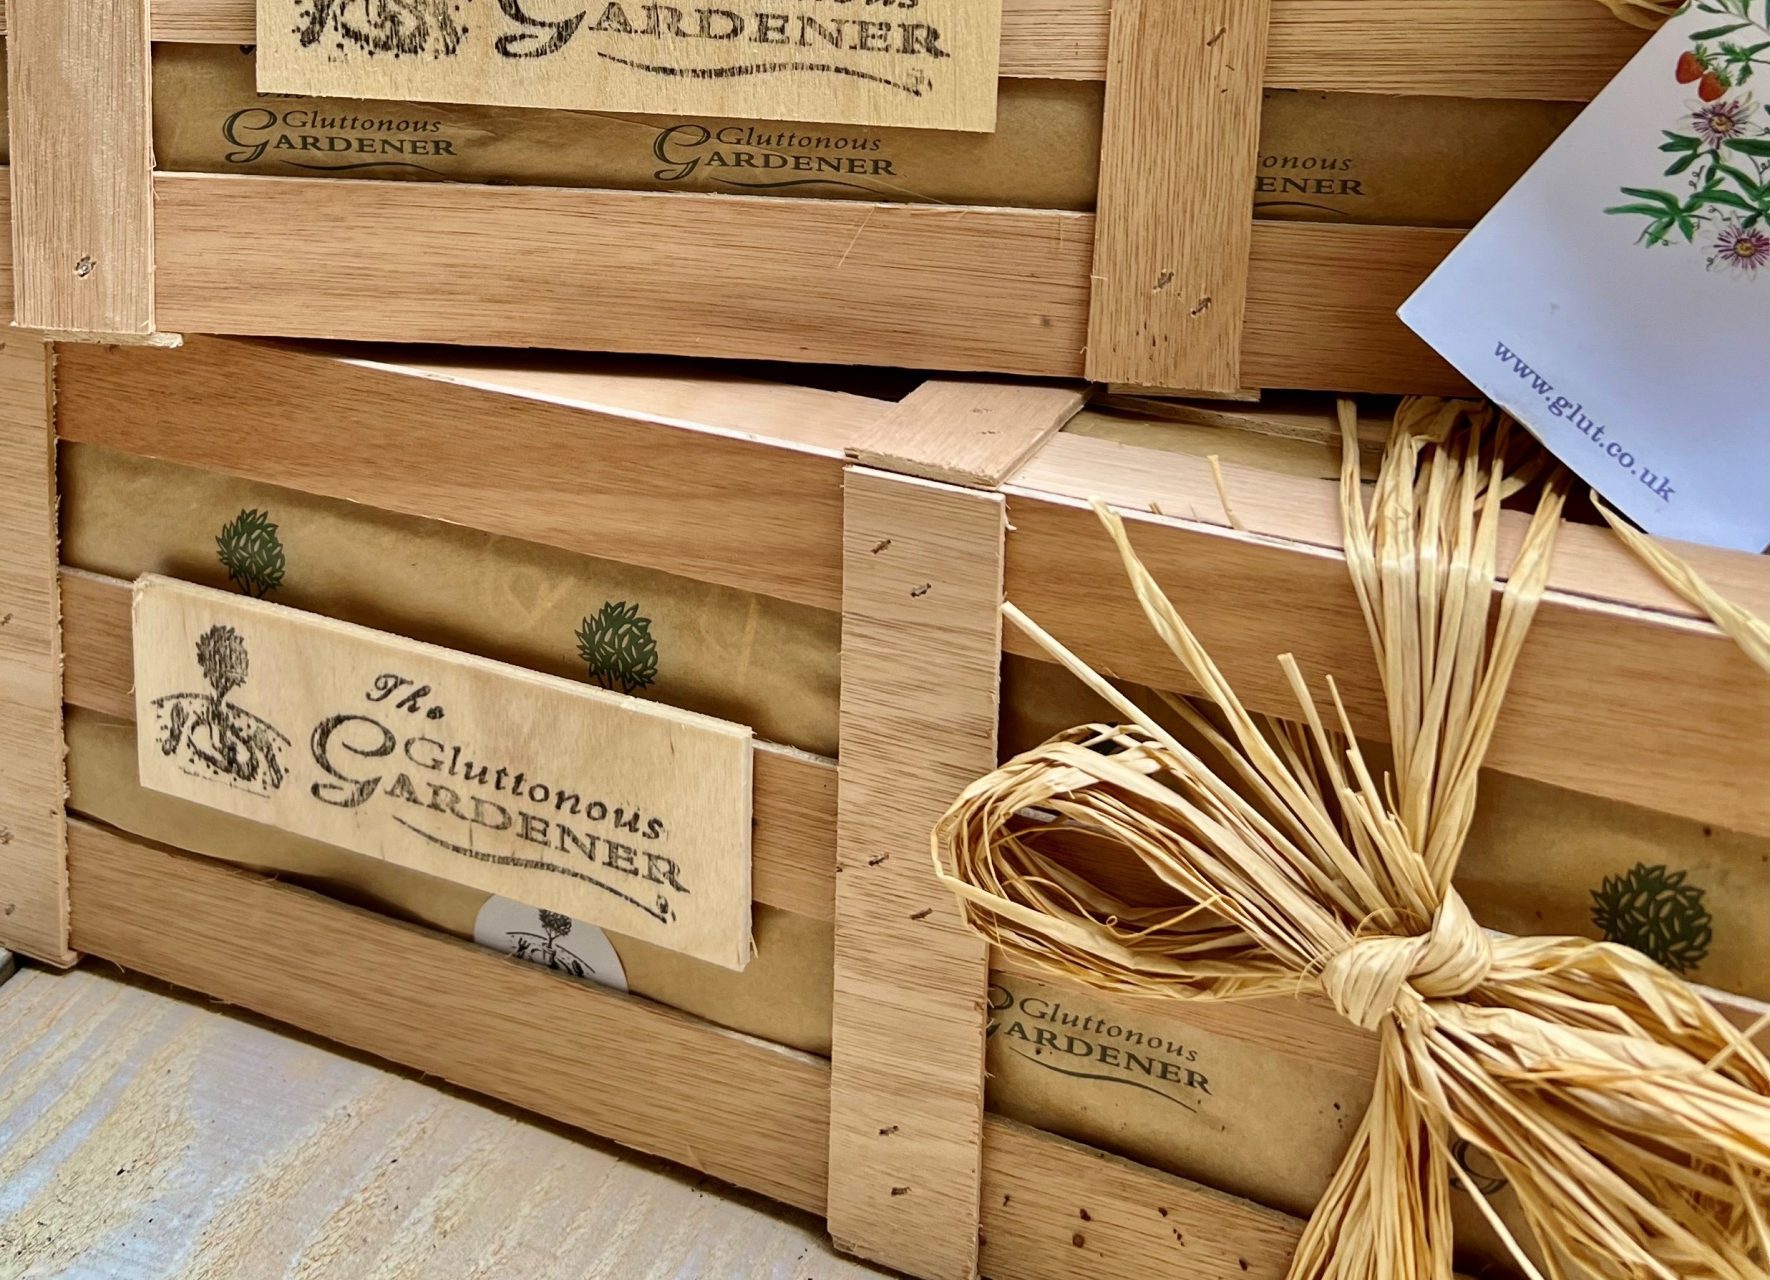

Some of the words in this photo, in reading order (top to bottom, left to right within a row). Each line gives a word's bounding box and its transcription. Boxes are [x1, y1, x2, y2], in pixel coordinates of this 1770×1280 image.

[222, 108, 457, 164] GARDENER
[282, 110, 442, 132] Gluttonous
[716, 126, 882, 152] Gluttonous
[653, 124, 897, 181] GARDENER
[1493, 341, 1676, 503] www.glut.co.uk
[365, 673, 445, 720] The
[310, 714, 692, 894] GARDENER
[403, 735, 665, 840] Gluttonous
[1019, 997, 1199, 1062] Gluttonous
